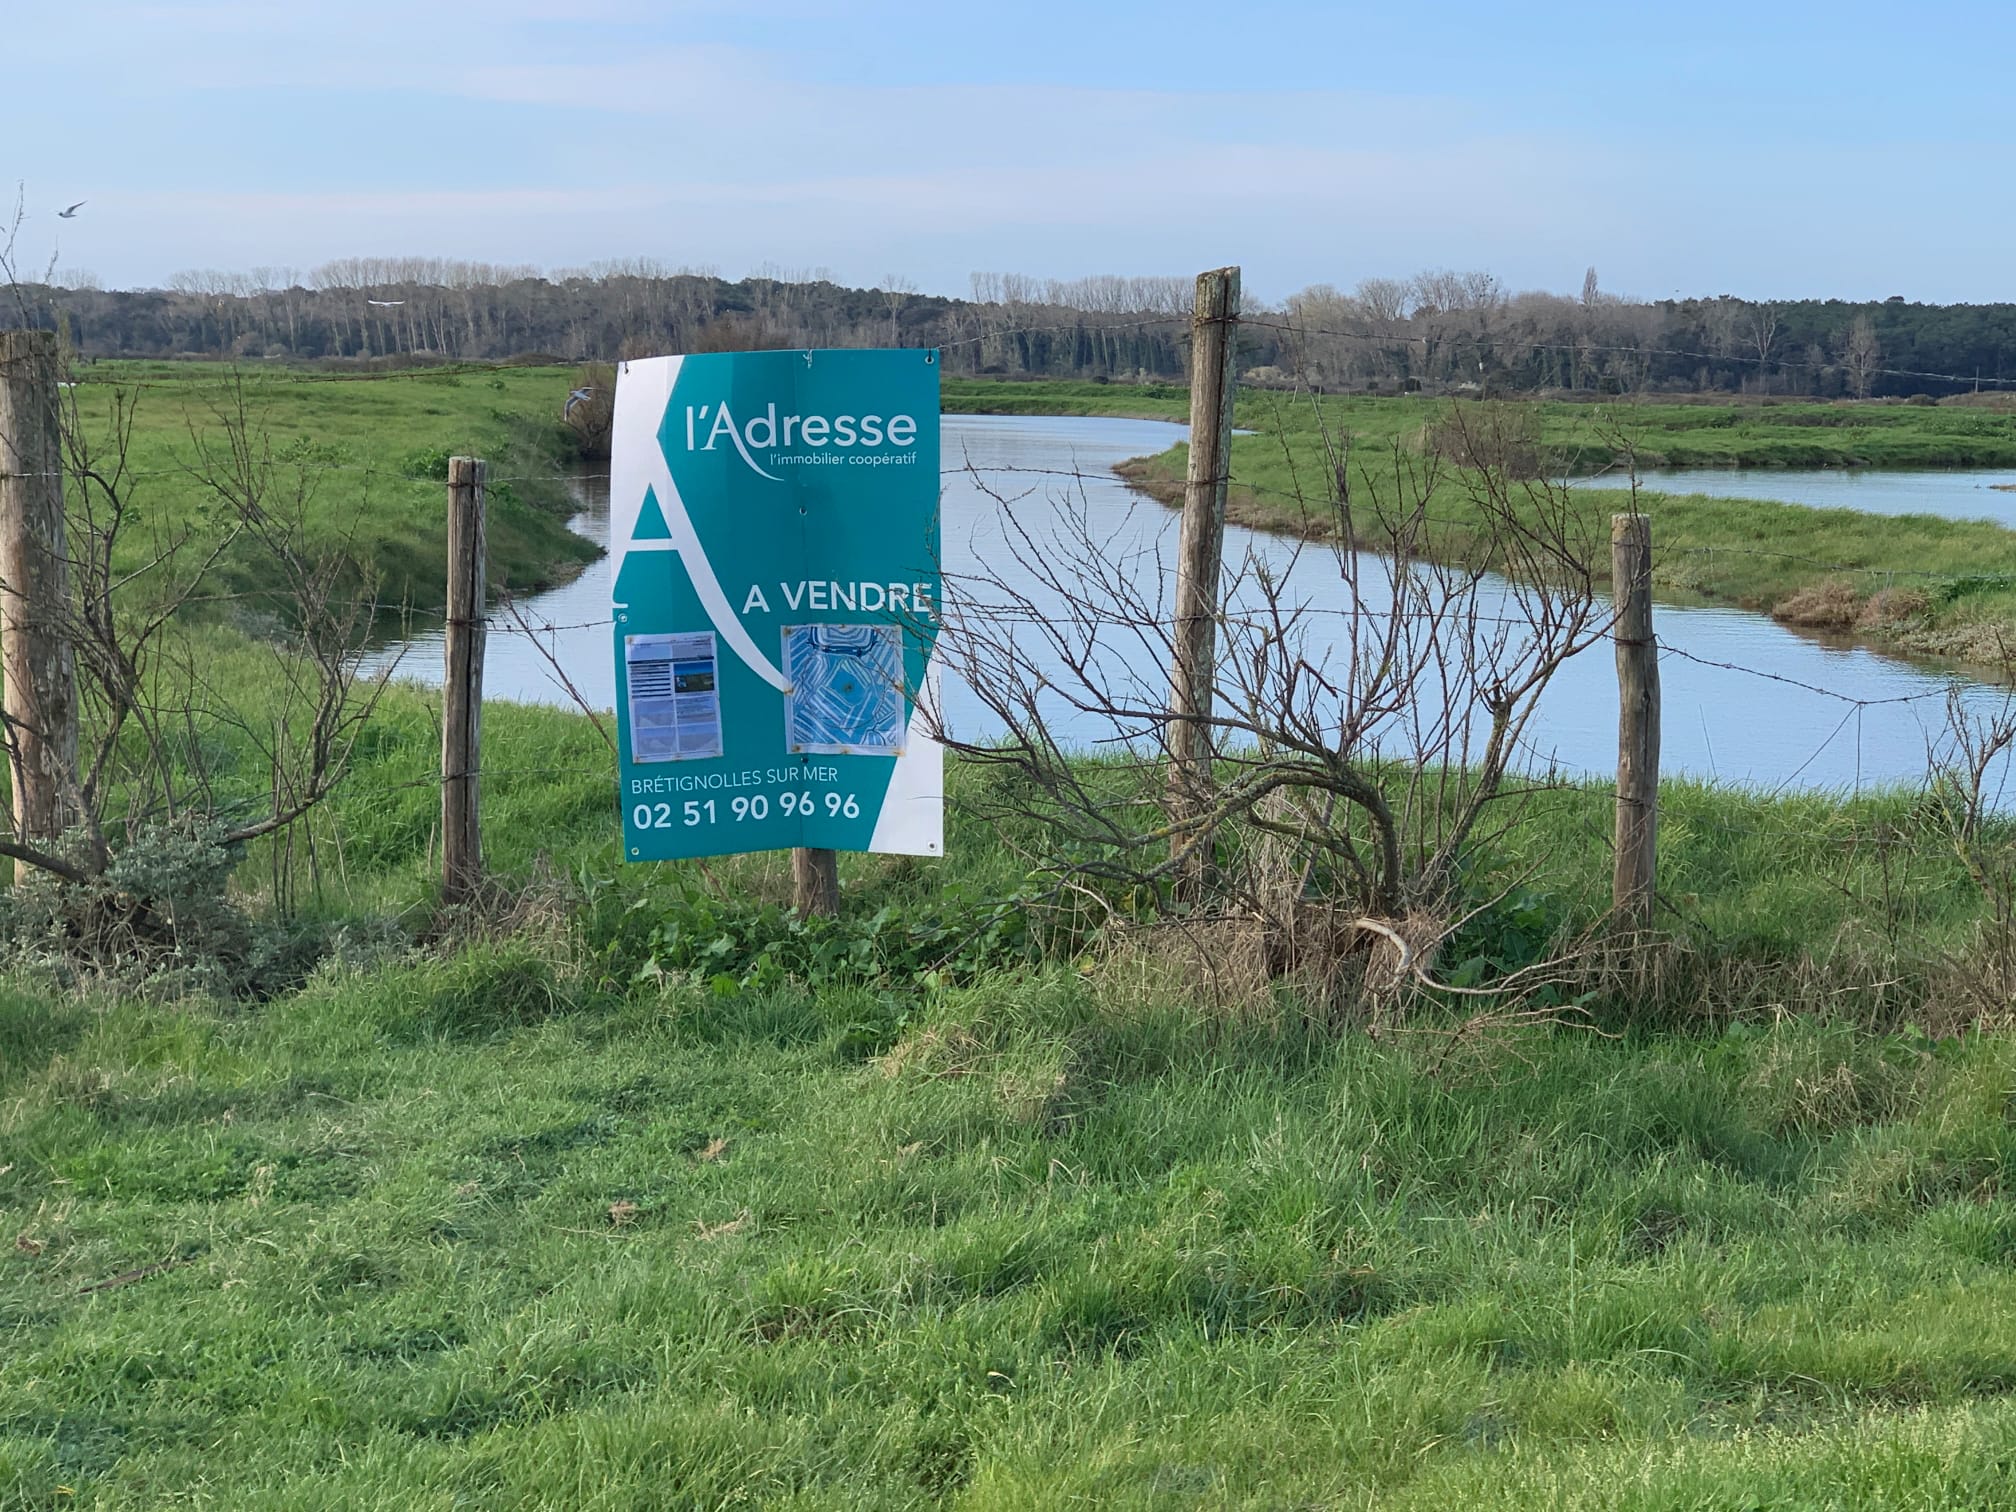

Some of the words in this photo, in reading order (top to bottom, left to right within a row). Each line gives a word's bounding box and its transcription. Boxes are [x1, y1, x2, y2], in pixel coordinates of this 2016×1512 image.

[686, 400, 917, 481] l'Adresse
[770, 452, 844, 466] l'immobilier
[848, 451, 917, 468] coopératif
[742, 584, 770, 614] A
[780, 580, 933, 613] VENDRE
[631, 769, 762, 794] BRÉTIGNOLLES
[767, 767, 799, 783] SUR
[803, 766, 838, 782] MER
[632, 803, 671, 830] 02
[683, 799, 716, 826] 51
[731, 794, 769, 822] 90
[778, 791, 815, 817] 96
[824, 792, 860, 819] 96
